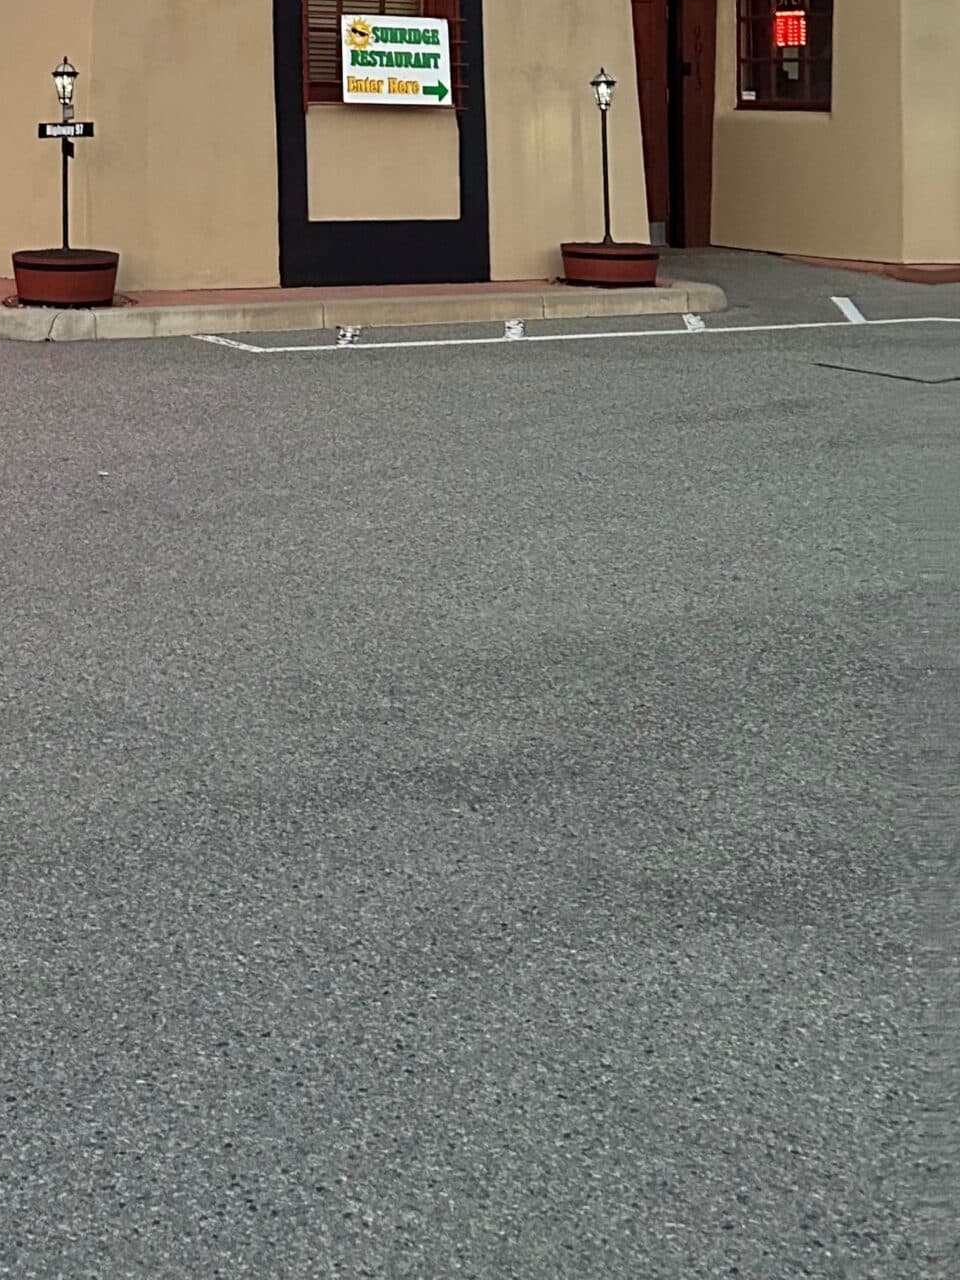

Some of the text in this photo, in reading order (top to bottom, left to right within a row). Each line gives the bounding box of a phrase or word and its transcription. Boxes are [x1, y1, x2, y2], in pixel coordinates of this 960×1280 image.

[372, 26, 440, 45] SUNRIDGE
[350, 49, 441, 69] RESTAURANT
[347, 76, 420, 94] Enter Here
